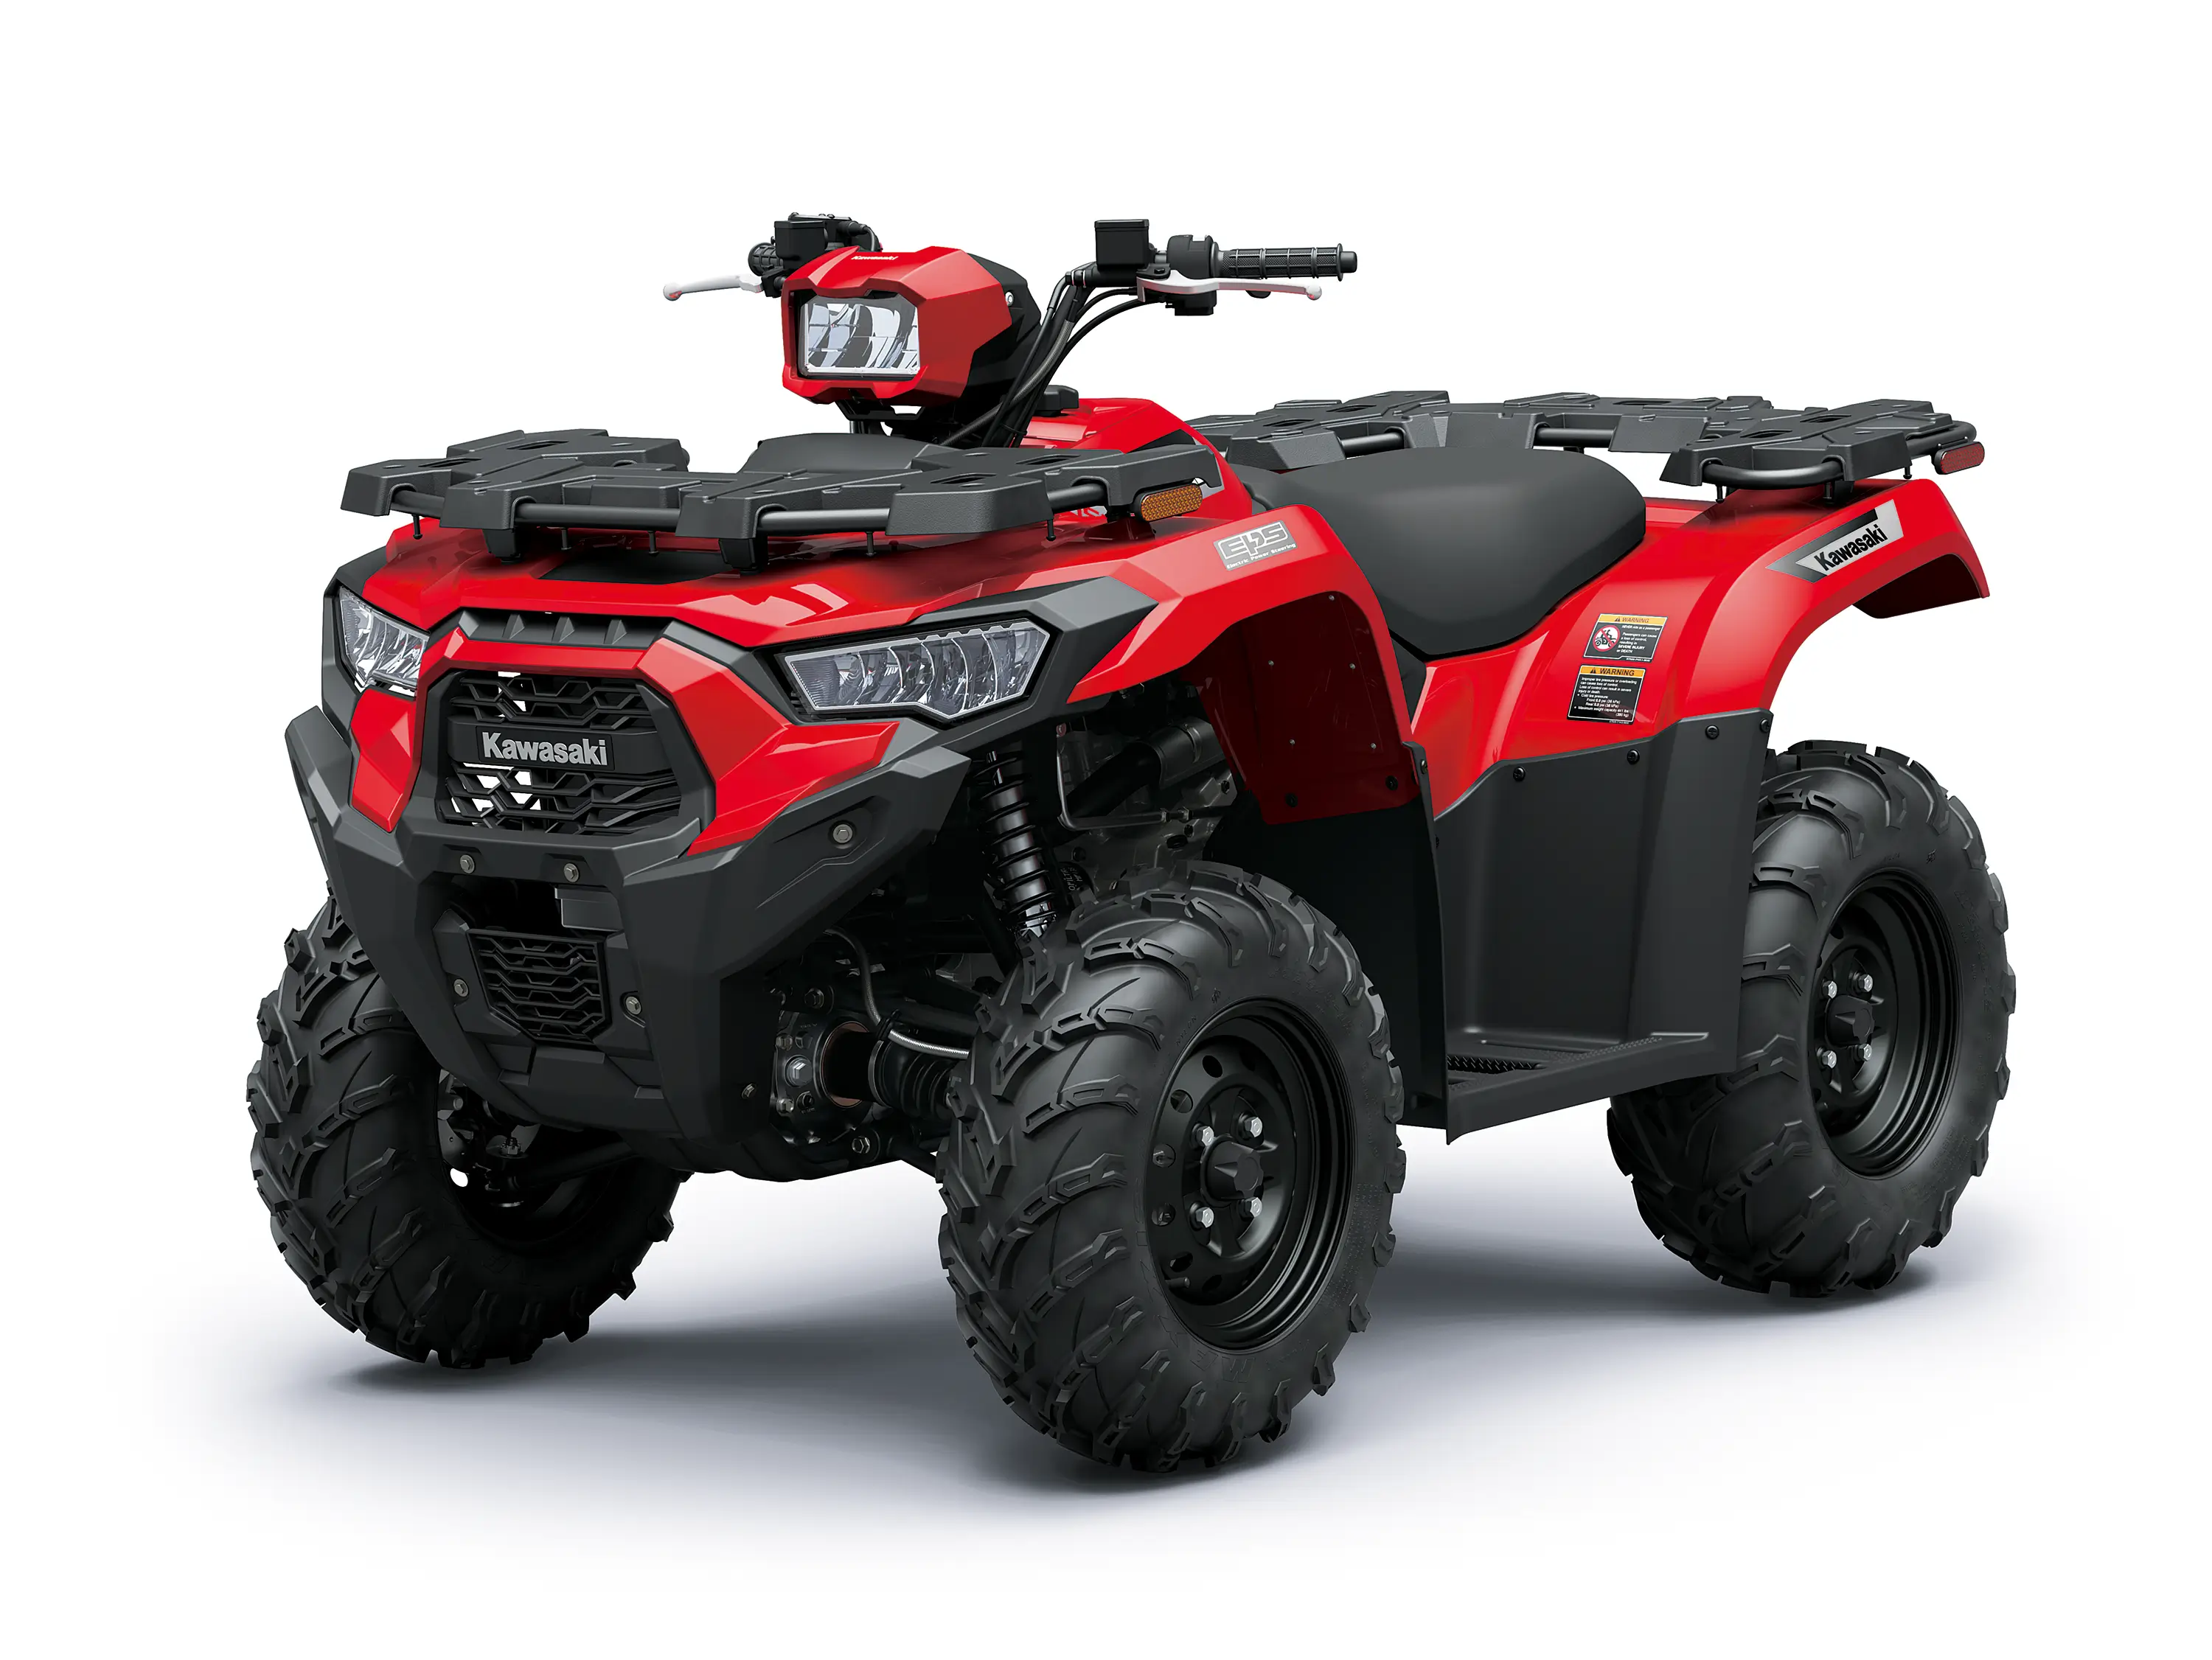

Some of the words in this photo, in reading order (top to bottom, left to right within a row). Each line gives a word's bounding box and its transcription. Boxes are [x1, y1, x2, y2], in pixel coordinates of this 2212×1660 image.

[1218, 521, 1288, 559] EPS
[1227, 559, 1249, 569] Electric
[1251, 552, 1269, 561] Power
[1270, 543, 1296, 554] Steering
[1814, 523, 1888, 571] Kawasaki
[1599, 667, 1635, 676] WARNING
[481, 731, 608, 766] Kawasaki
